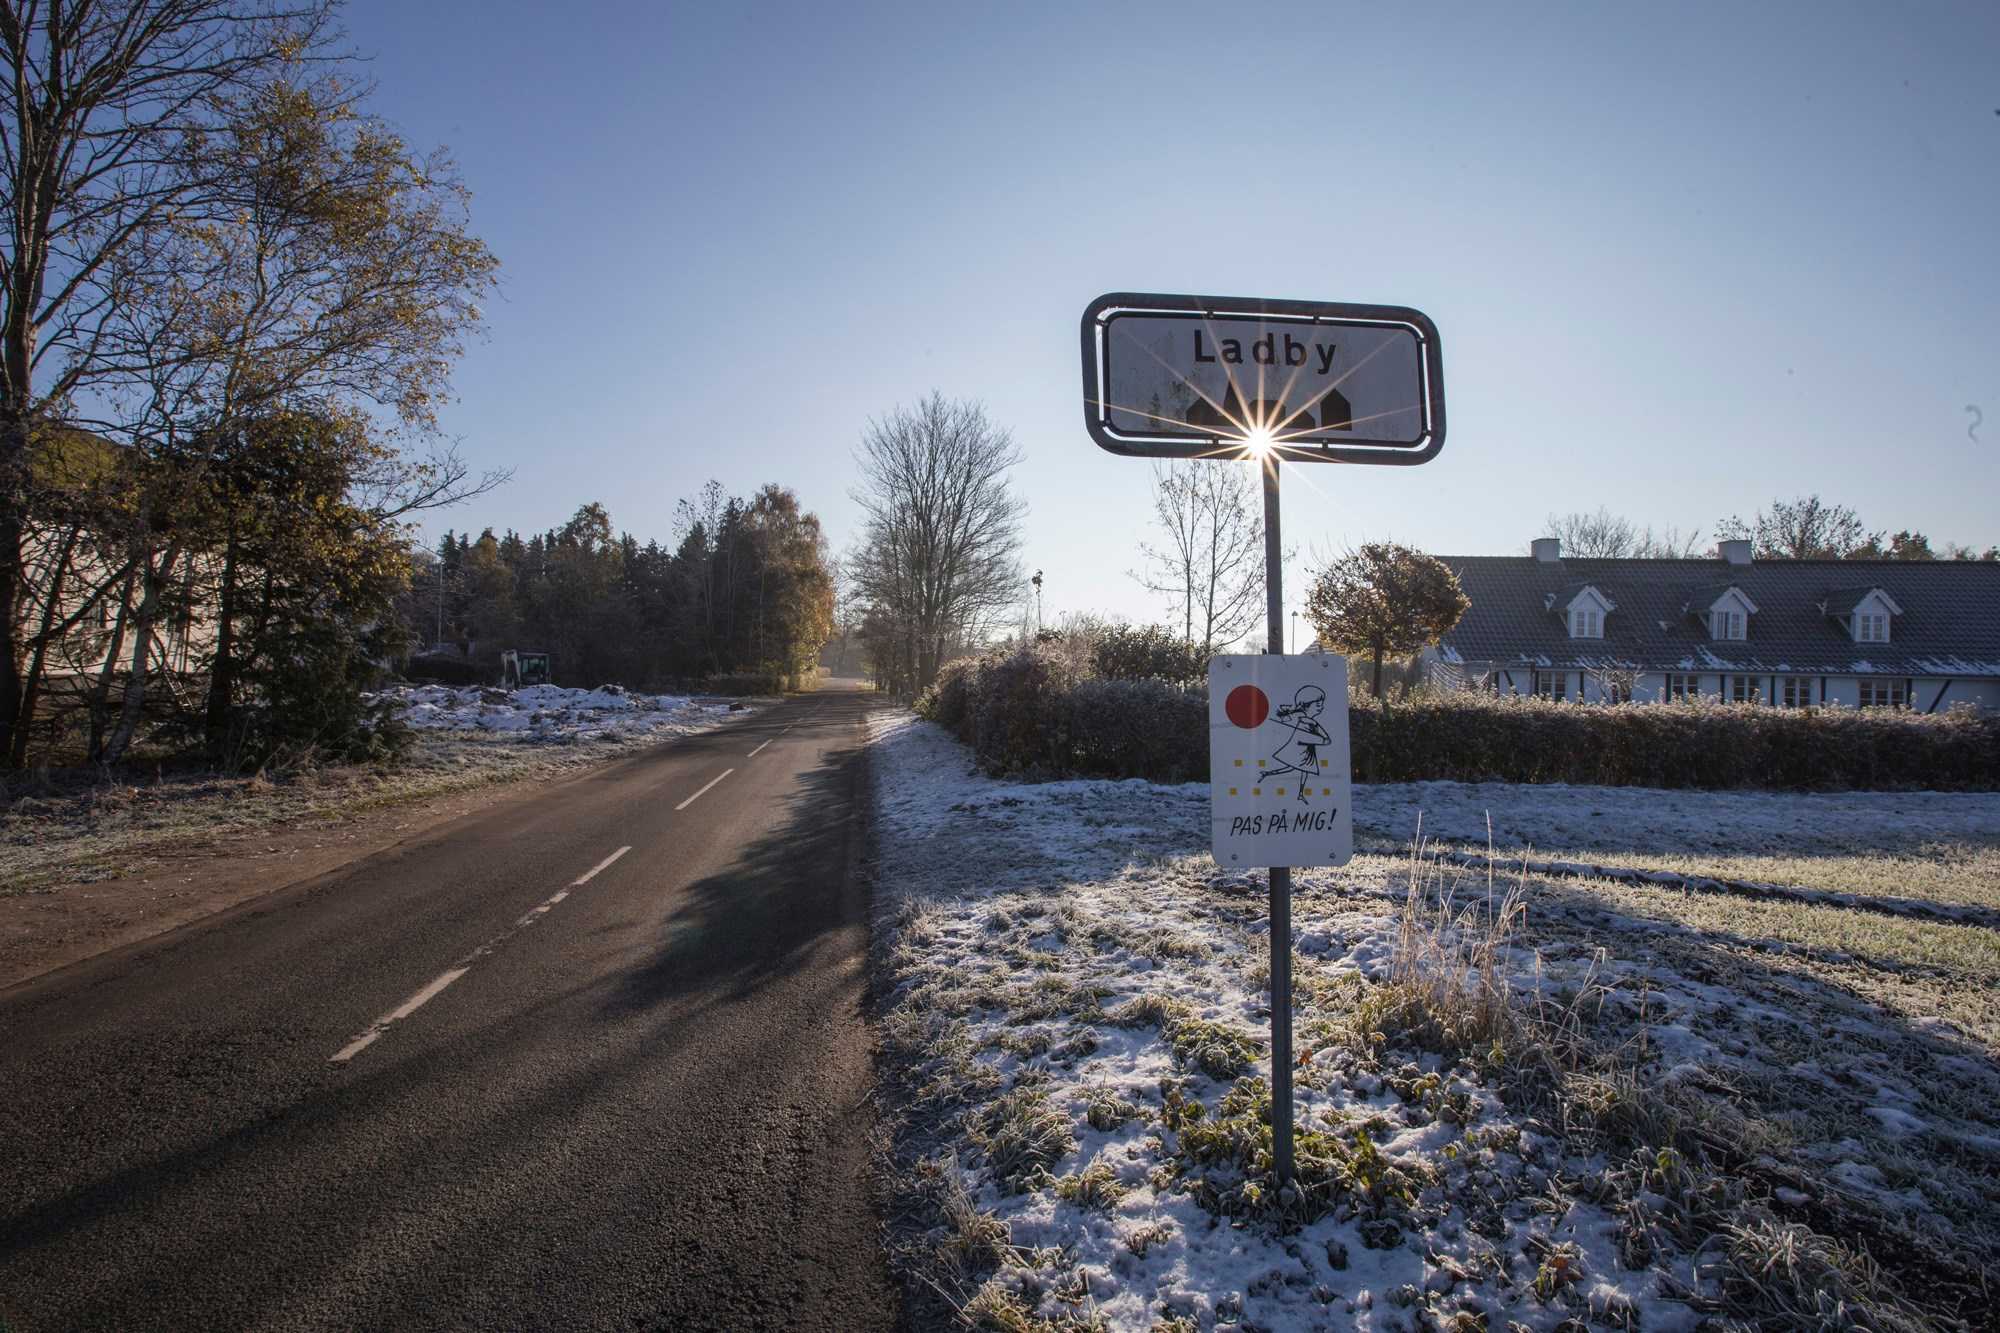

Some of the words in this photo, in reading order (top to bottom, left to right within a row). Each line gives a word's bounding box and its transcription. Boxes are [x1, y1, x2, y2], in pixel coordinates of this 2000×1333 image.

[1193, 329, 1337, 375] Ladby
[1230, 815, 1262, 836] PAS
[1267, 808, 1288, 834] PÅ
[1292, 808, 1337, 832] MIG!
